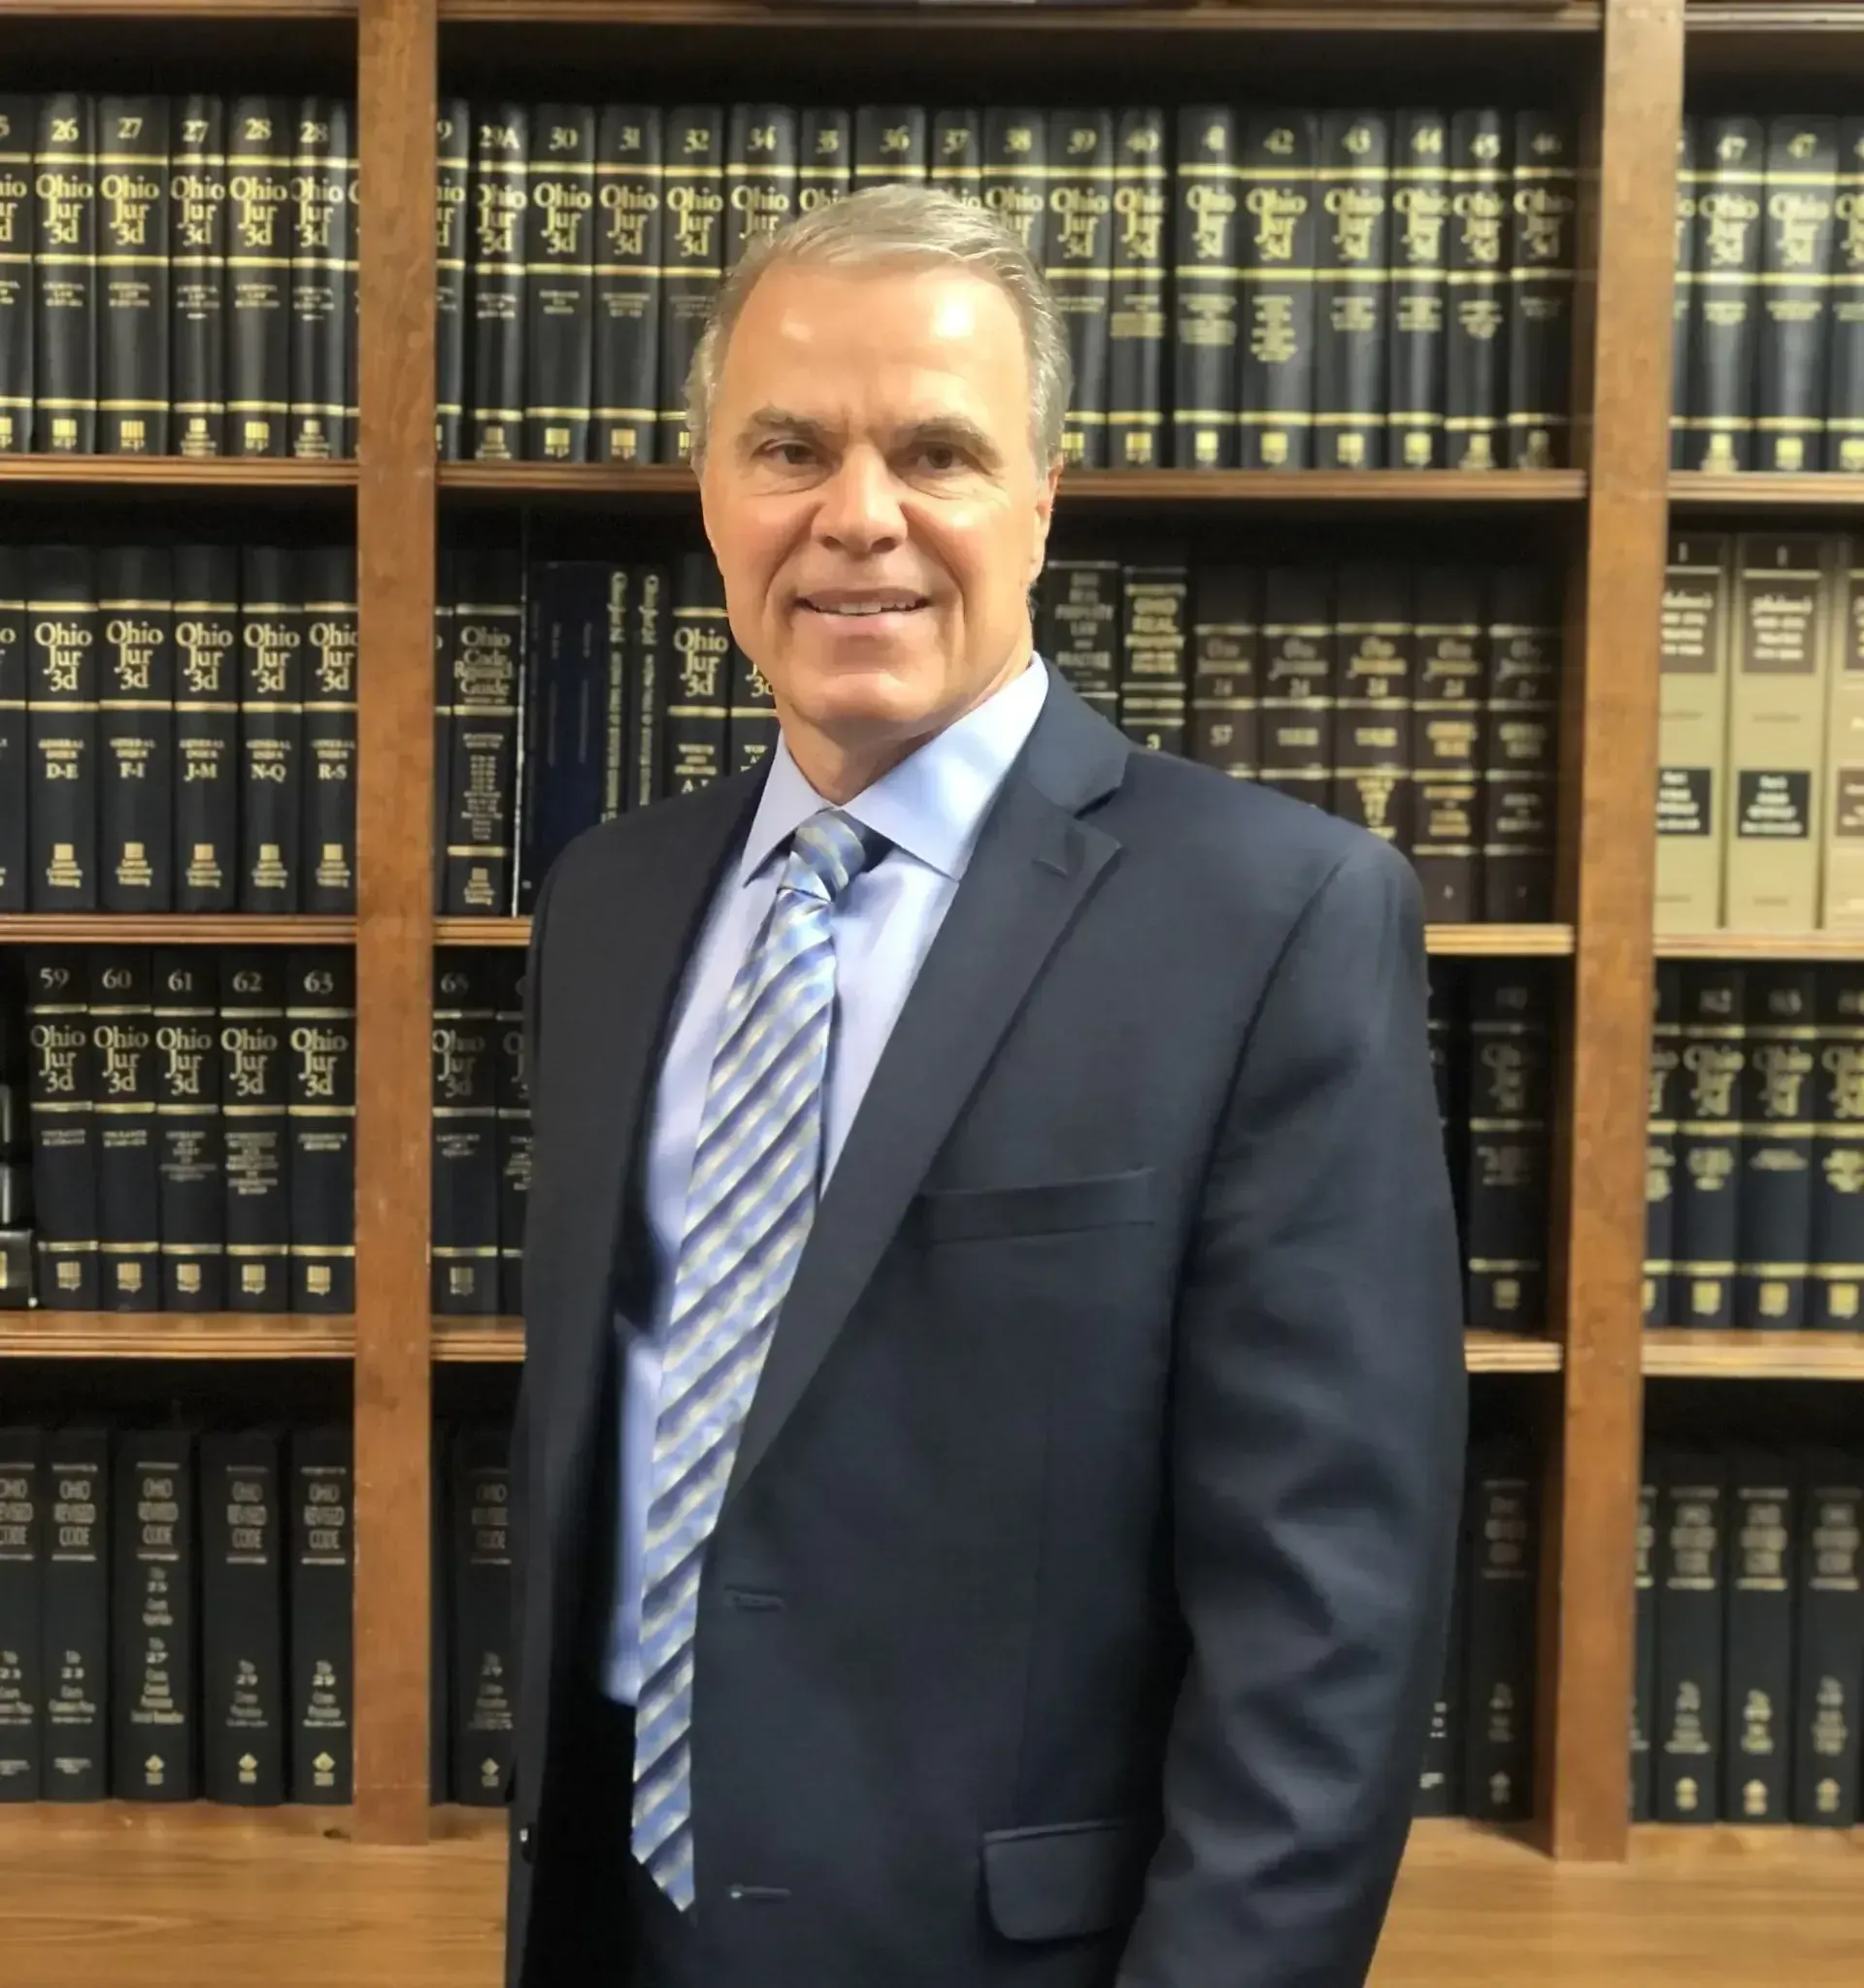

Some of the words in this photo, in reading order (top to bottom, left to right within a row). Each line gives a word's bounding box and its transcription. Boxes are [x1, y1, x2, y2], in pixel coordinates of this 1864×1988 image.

[51, 117, 79, 142] 26
[117, 117, 143, 139] 27
[183, 119, 209, 143] 27
[245, 117, 272, 141] 28
[549, 126, 579, 150] 30
[683, 128, 710, 153] 32
[36, 174, 94, 201] Ohio
[101, 174, 160, 201] Ohio
[171, 175, 225, 201] Ohio
[230, 175, 287, 202] Ohio
[291, 176, 344, 203] Ohio
[534, 182, 593, 210] Ohio
[599, 183, 660, 212] Ohio
[667, 185, 723, 213] Ohio
[731, 184, 790, 212] Ohio
[985, 185, 1044, 213] Ohio
[1050, 187, 1111, 214] Ohio
[43, 197, 83, 228] Jur
[109, 197, 150, 229] Jur
[177, 198, 216, 229] Jur
[237, 198, 279, 230] Jur
[294, 200, 334, 231] Jur
[541, 206, 582, 237] Jur
[607, 208, 649, 238] Jur
[675, 209, 715, 241] Jur
[50, 219, 79, 245] 3d
[117, 219, 145, 246] 3d
[183, 221, 212, 247] 3d
[245, 221, 273, 247] 3d
[300, 223, 329, 248] 3d
[547, 232, 577, 254] 3d
[614, 233, 644, 255] 3d
[681, 234, 709, 257] 3d
[34, 621, 93, 647] Ohio
[106, 619, 164, 646] Ohio
[176, 621, 233, 648] Ohio
[244, 623, 301, 649] Ohio
[460, 625, 512, 647] Ohio
[674, 626, 729, 653] Ohio
[43, 645, 83, 676] Jur
[114, 643, 153, 674] Jur
[183, 645, 224, 677] Jur
[250, 646, 290, 678] Jur
[316, 646, 355, 677] Jur
[680, 649, 720, 681] Jur
[50, 667, 78, 692] 3d
[120, 665, 150, 690] 3d
[189, 668, 218, 693] 3d
[257, 669, 285, 694] 3d
[321, 669, 350, 693] 3d
[684, 674, 715, 697] 3d
[46, 762, 79, 779] D-E
[120, 762, 145, 779] F-I
[183, 762, 216, 782] J-M
[251, 763, 286, 783] N-Q
[317, 763, 347, 779] R-S
[40, 968, 70, 990] 59
[102, 969, 132, 989] 60
[168, 972, 192, 991] 61
[233, 972, 263, 993] 62
[304, 971, 333, 994] 63
[31, 1025, 86, 1049] Ohio
[93, 1026, 149, 1050] Ohio
[155, 1027, 213, 1052] Ohio
[220, 1028, 278, 1053] Ohio
[290, 1027, 349, 1053] Ohio
[39, 1046, 77, 1077] Jur
[102, 1047, 140, 1077] Jur
[164, 1048, 203, 1079] Jur
[229, 1050, 268, 1080] Jur
[298, 1050, 337, 1081] Jur
[46, 1070, 75, 1093] 3d
[109, 1071, 136, 1094] 3d
[170, 1072, 199, 1096] 3d
[237, 1073, 265, 1097] 3d
[306, 1074, 334, 1098] 3d
